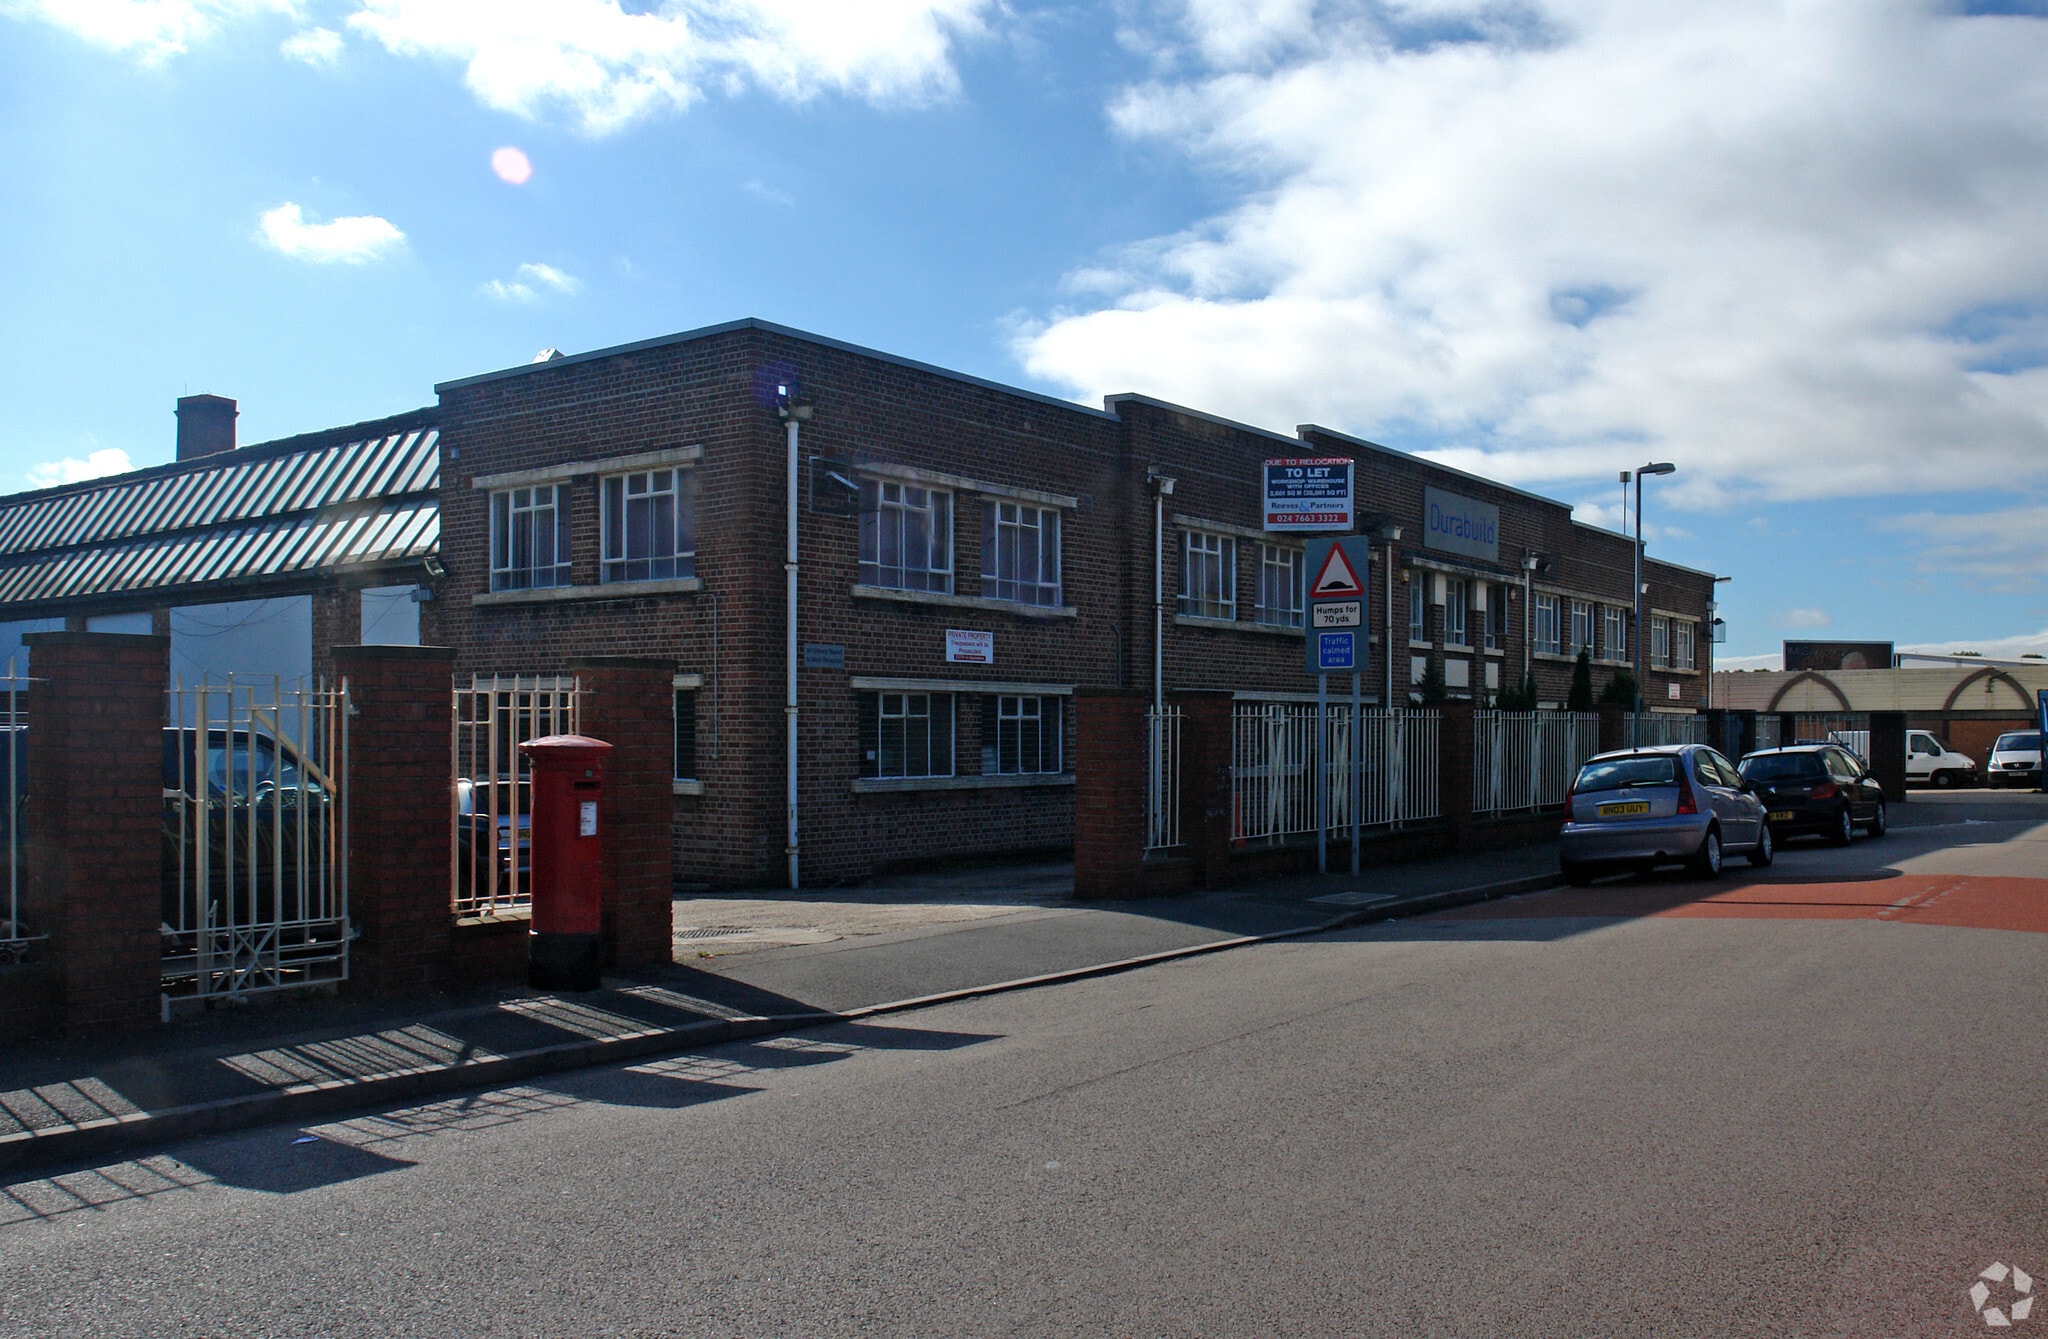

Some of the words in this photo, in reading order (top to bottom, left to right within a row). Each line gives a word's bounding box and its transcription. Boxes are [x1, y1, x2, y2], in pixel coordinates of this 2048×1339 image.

[1300, 458, 1351, 466] RELOCATION
[1285, 468, 1303, 478] TO
[1307, 468, 1331, 478] LET
[1299, 501, 1310, 512] &
[1318, 514, 1339, 522] 3322
[1430, 503, 1495, 545] Durabuild
[1324, 615, 1334, 623] 70
[1336, 615, 1350, 624] yds
[948, 631, 967, 639] PRIVATE
[968, 632, 991, 640] PROPERTY
[1324, 637, 1349, 645] Traffic
[1322, 646, 1350, 654] calmed
[1603, 805, 1625, 815] BN03
[1626, 804, 1644, 813] UUY
